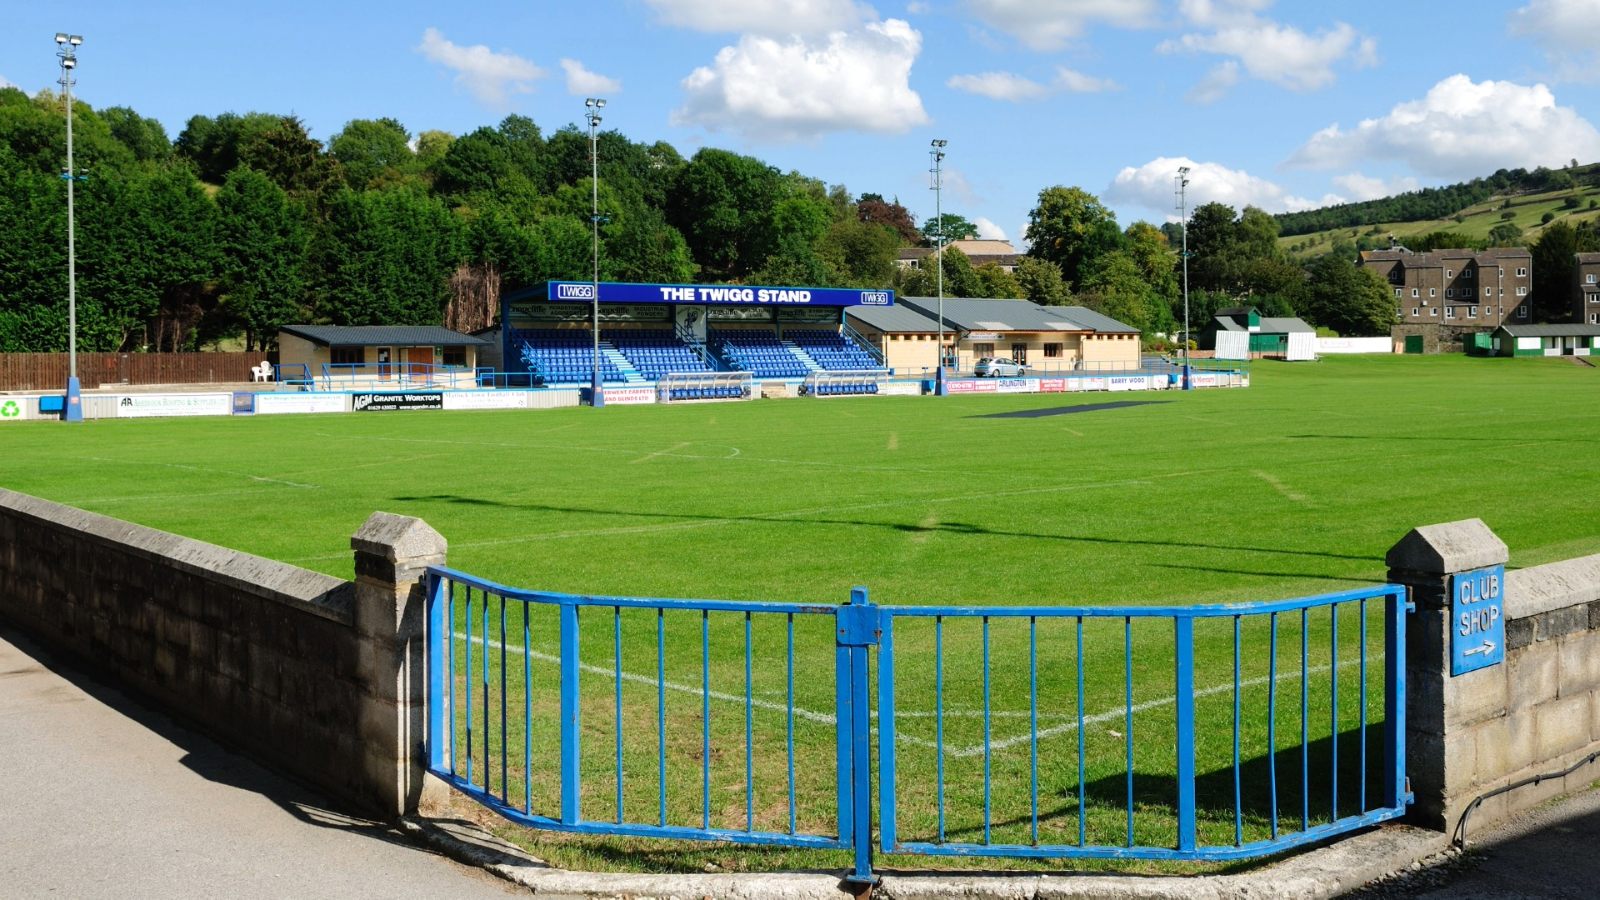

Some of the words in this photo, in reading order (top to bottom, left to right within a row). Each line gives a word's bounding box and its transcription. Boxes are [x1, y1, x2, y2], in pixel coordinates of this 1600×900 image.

[562, 285, 592, 297] TWIGG
[660, 287, 695, 301] THE
[698, 287, 754, 302] TWIGG
[757, 288, 811, 303] STAND
[352, 394, 372, 411] AGM
[373, 394, 404, 402] GRANITE
[404, 394, 441, 402] WORKTOPS
[1460, 574, 1499, 605] CLUB
[1460, 605, 1499, 636] SHOP
